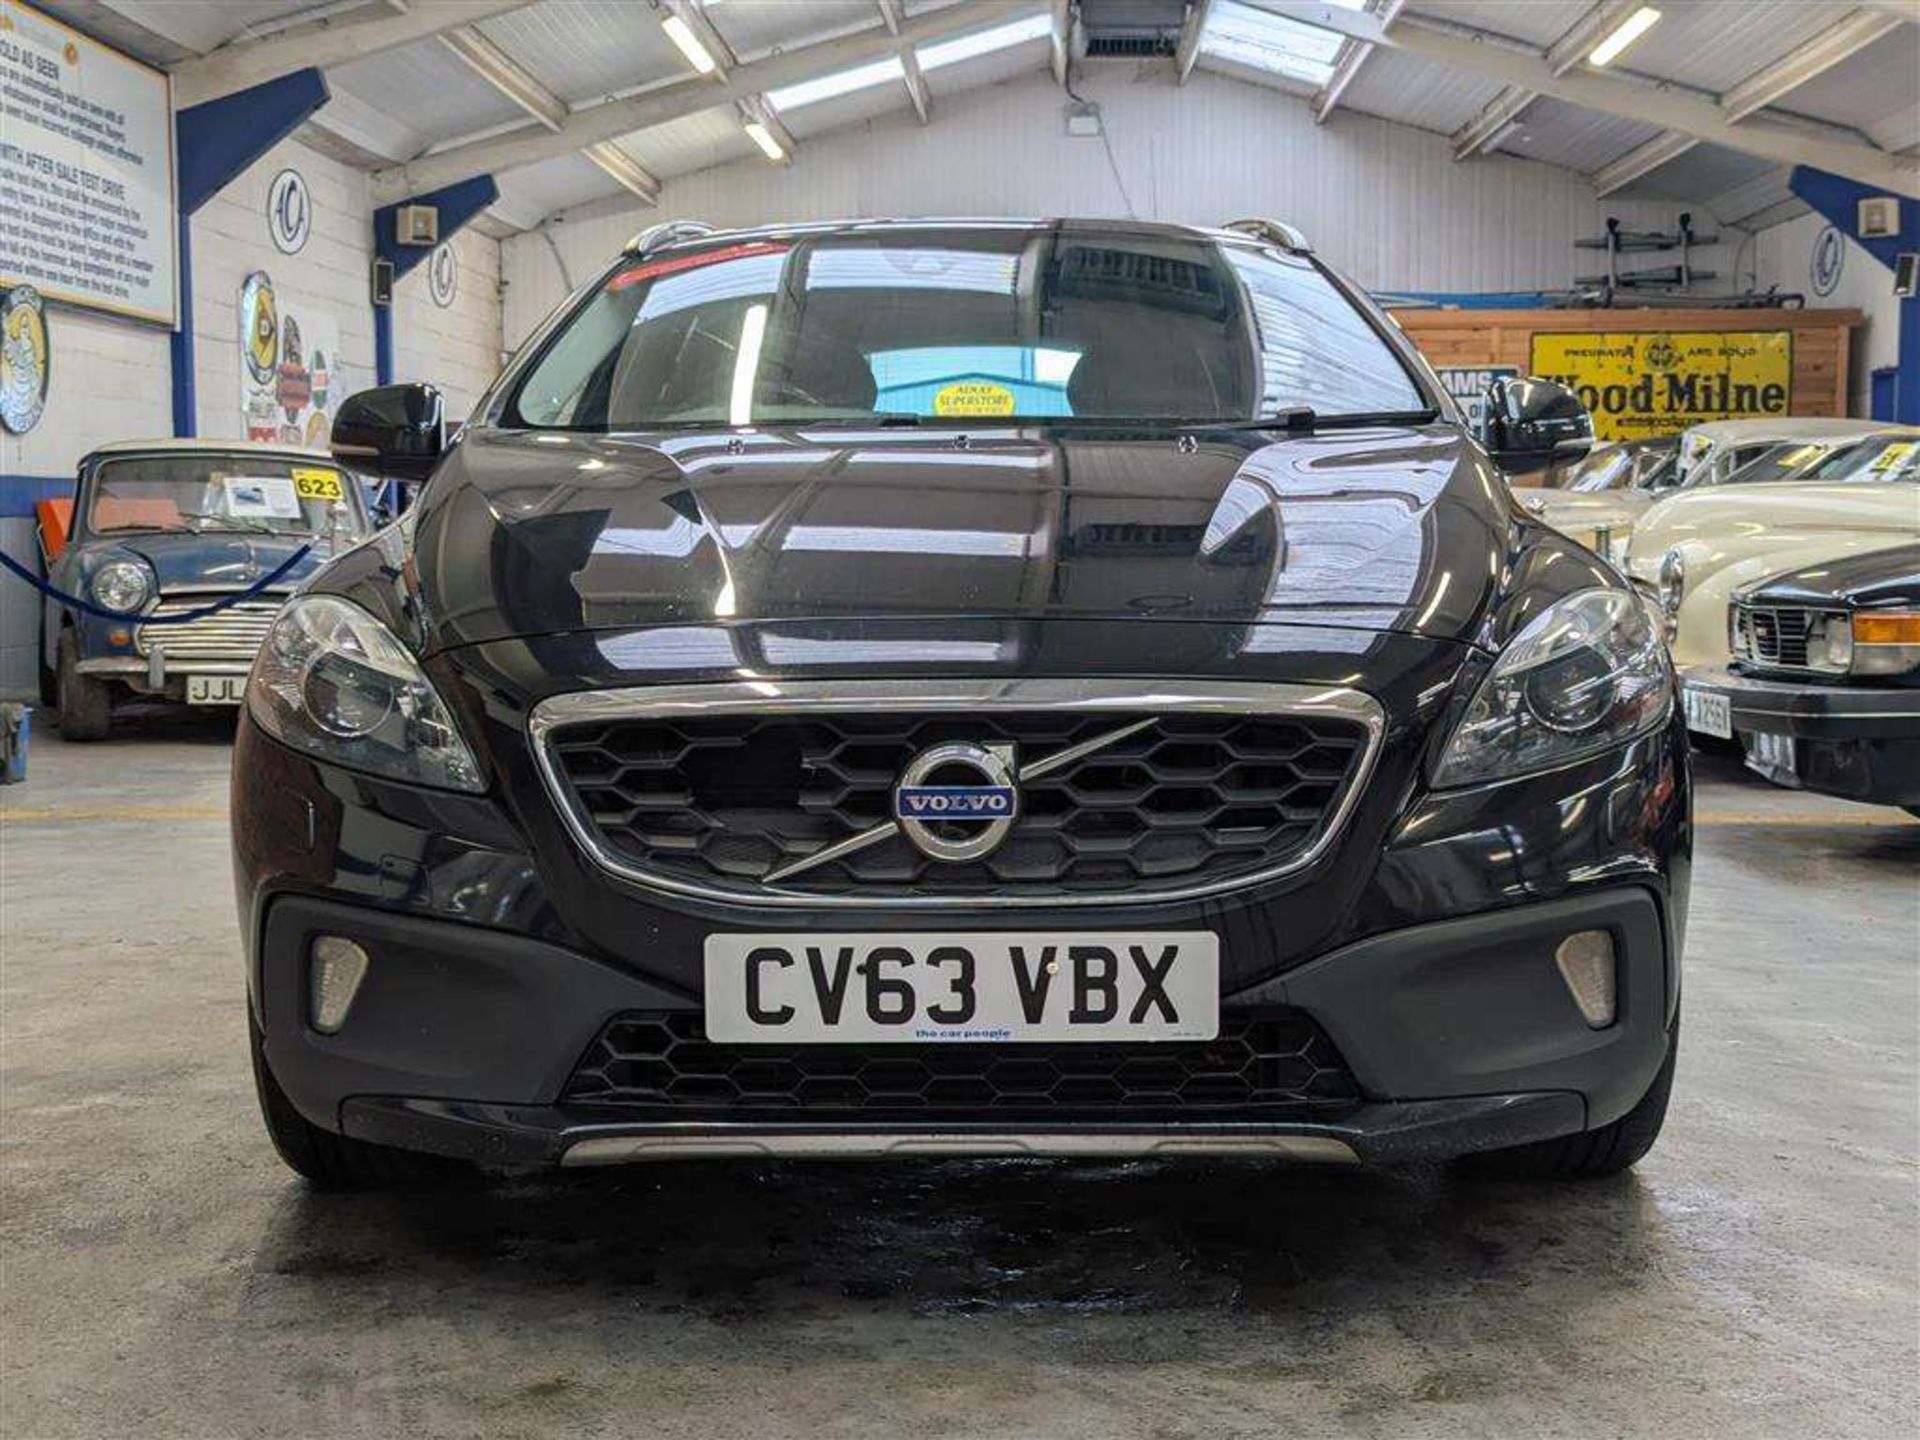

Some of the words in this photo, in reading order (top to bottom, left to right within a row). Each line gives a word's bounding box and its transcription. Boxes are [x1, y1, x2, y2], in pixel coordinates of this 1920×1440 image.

[26, 152, 53, 174] AFTER
[56, 162, 78, 185] SALE
[80, 170, 100, 190] TEST
[102, 177, 125, 200] DRIVE
[298, 478, 341, 497] 623
[906, 795, 1007, 810] VOLVO
[745, 947, 976, 1025] CV63
[1009, 946, 1180, 1024] VBX
[916, 1029, 938, 1038] the
[940, 1030, 962, 1038] car
[964, 1029, 1011, 1039] people
